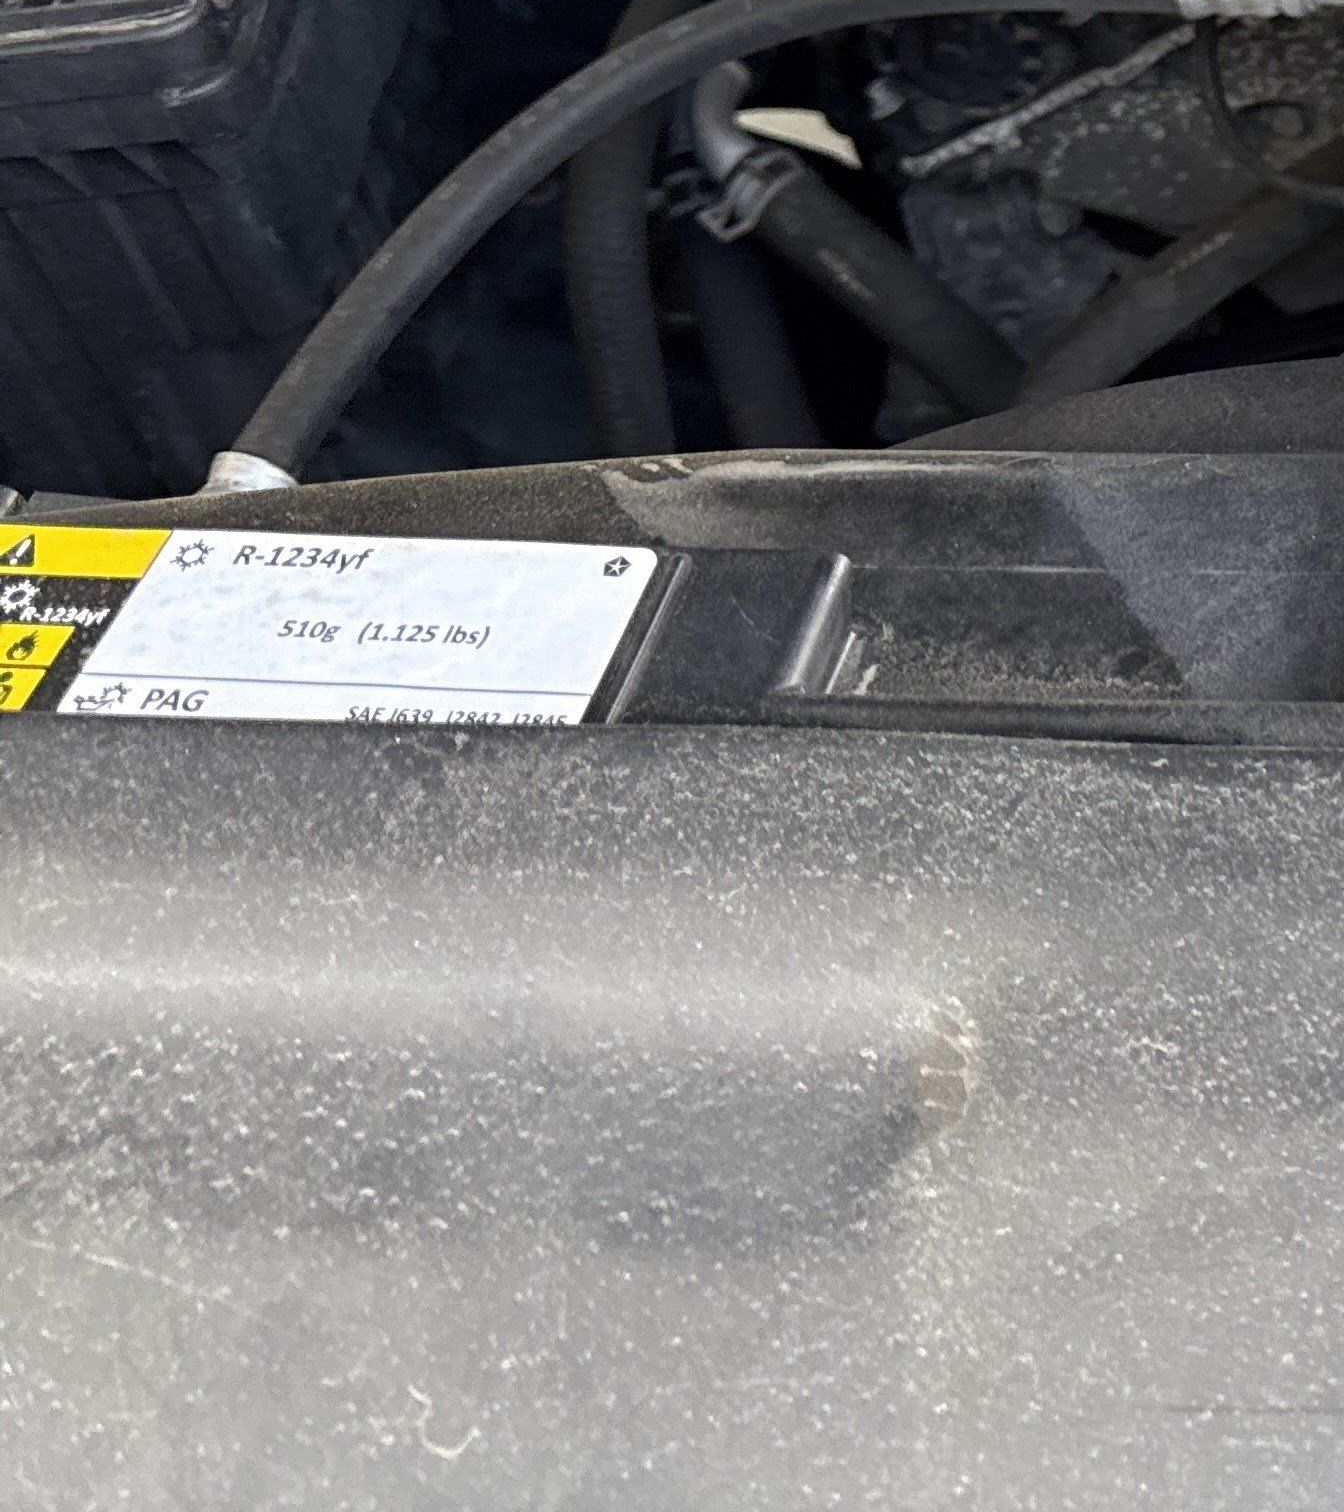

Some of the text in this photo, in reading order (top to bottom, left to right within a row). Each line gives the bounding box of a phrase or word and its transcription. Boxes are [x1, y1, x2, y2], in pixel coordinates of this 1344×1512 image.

[232, 547, 374, 570] R-1234yf
[19, 606, 111, 628] R-1234yf
[277, 619, 490, 648] 510g (1.125 lbs)
[140, 690, 210, 714] PAG
